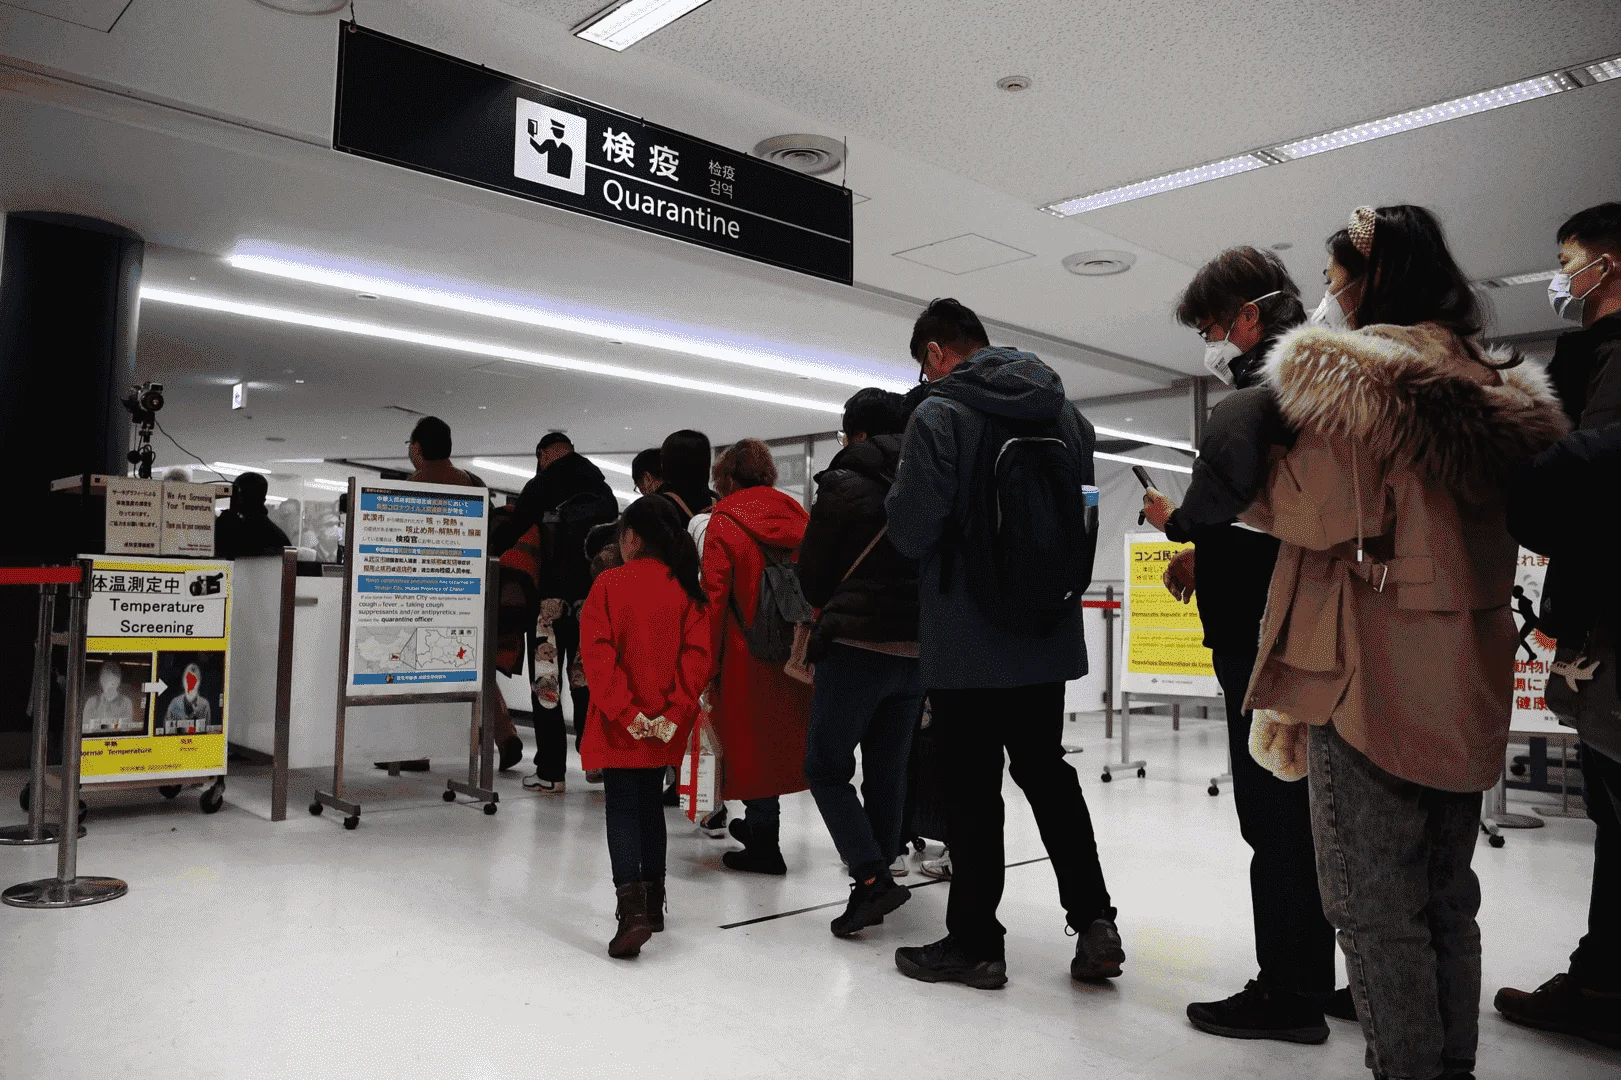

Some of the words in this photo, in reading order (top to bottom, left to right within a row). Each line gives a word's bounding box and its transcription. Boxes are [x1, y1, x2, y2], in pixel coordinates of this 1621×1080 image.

[602, 127, 679, 181] 検疫
[708, 159, 735, 182] 检疫
[709, 179, 733, 199] 검역
[603, 179, 740, 239] Quarantine
[167, 492, 175, 500] We
[189, 493, 212, 503] Screening
[167, 501, 179, 510] Your
[92, 574, 180, 594] 体温測定中
[109, 598, 205, 614] Temperature
[405, 601, 425, 609] taking
[120, 620, 194, 635] Screening
[108, 748, 152, 756] Temperature
